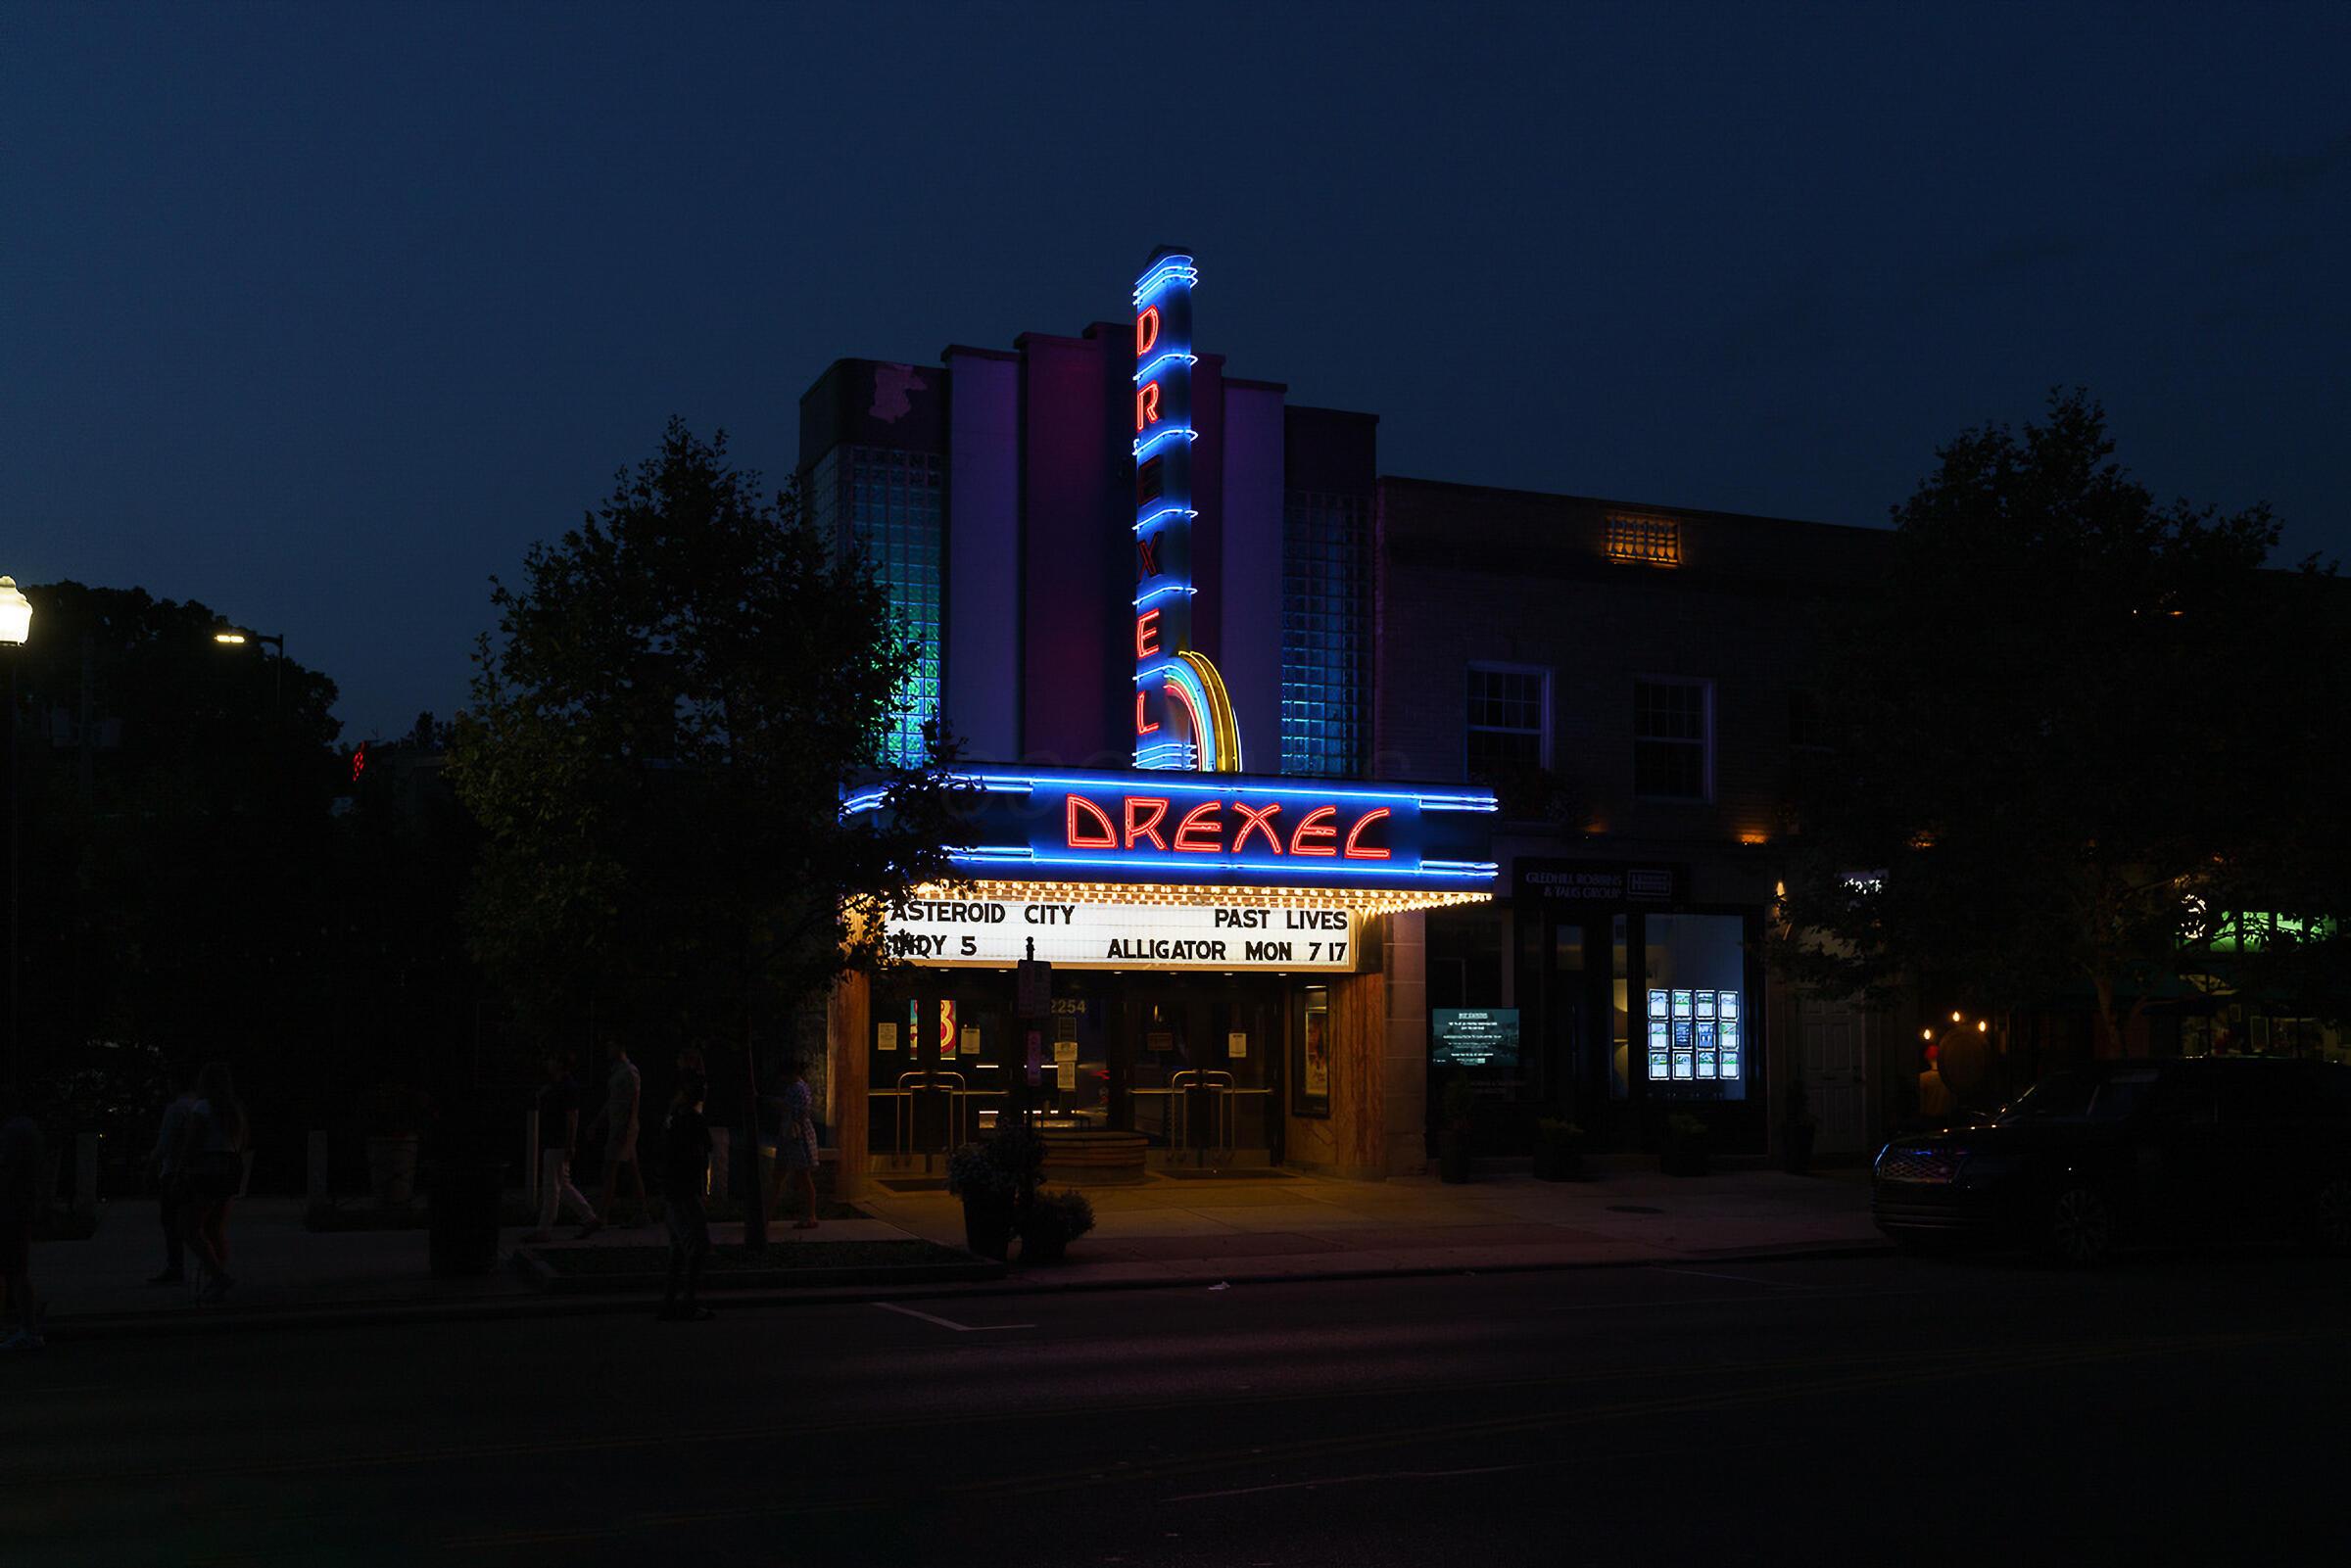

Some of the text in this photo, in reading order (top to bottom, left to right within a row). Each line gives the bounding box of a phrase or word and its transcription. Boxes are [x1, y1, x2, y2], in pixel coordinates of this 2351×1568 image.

[1135, 304, 1163, 736] DREXEL
[1066, 792, 1391, 860] DREXEL
[889, 901, 1076, 926] ASTEROID CITY
[1215, 908, 1348, 930] PAST LIVES
[960, 935, 978, 956] 5
[1107, 938, 1348, 962] ALLIGATOR MON 7 17
[1050, 998, 1087, 1015] 2254
